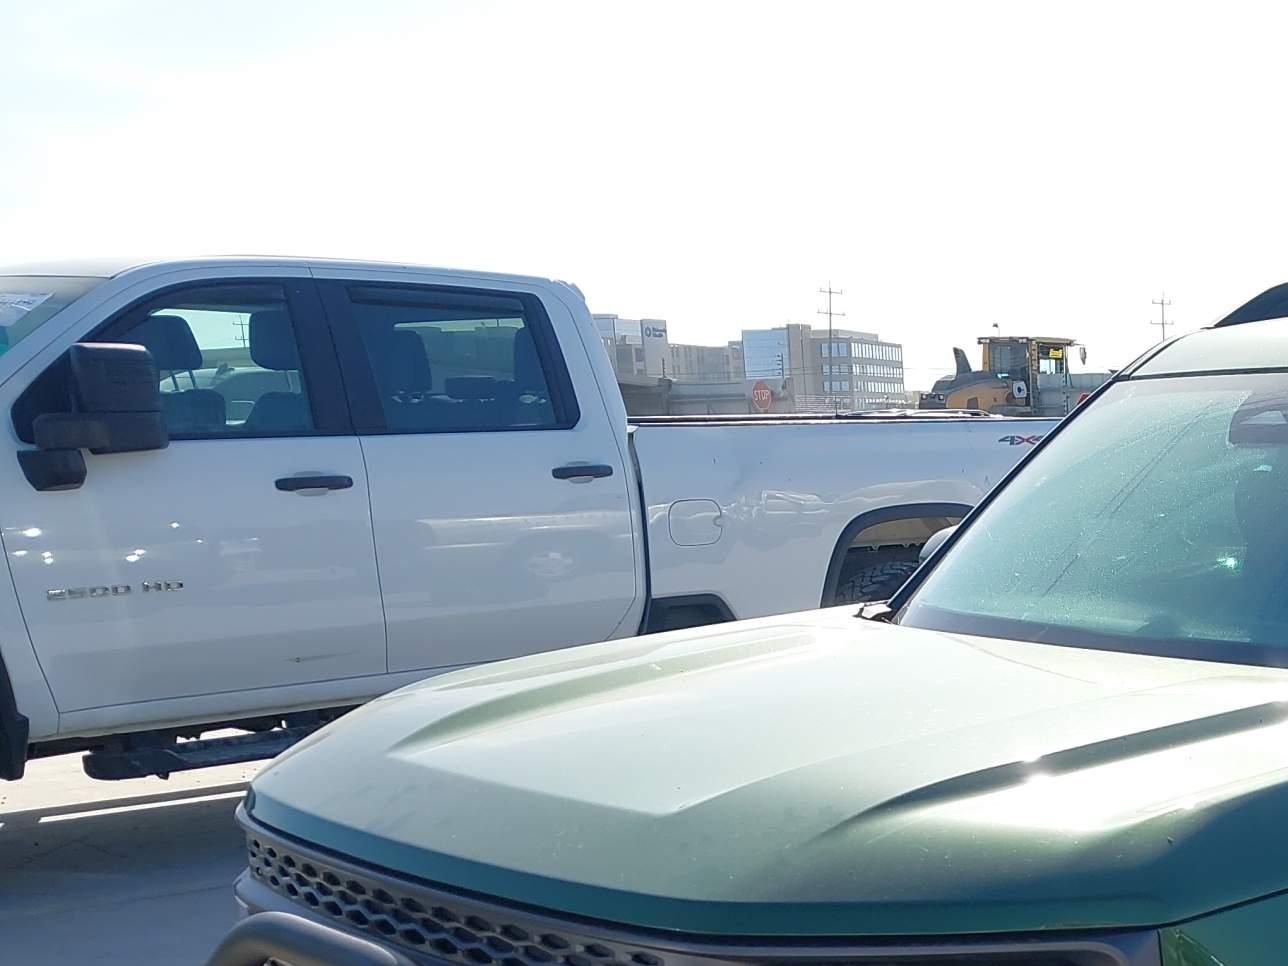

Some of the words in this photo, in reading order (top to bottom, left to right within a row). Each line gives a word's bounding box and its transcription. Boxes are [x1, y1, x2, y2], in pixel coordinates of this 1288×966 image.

[753, 389, 770, 401] STOP
[47, 584, 132, 600] 2500
[142, 580, 185, 593] HD
